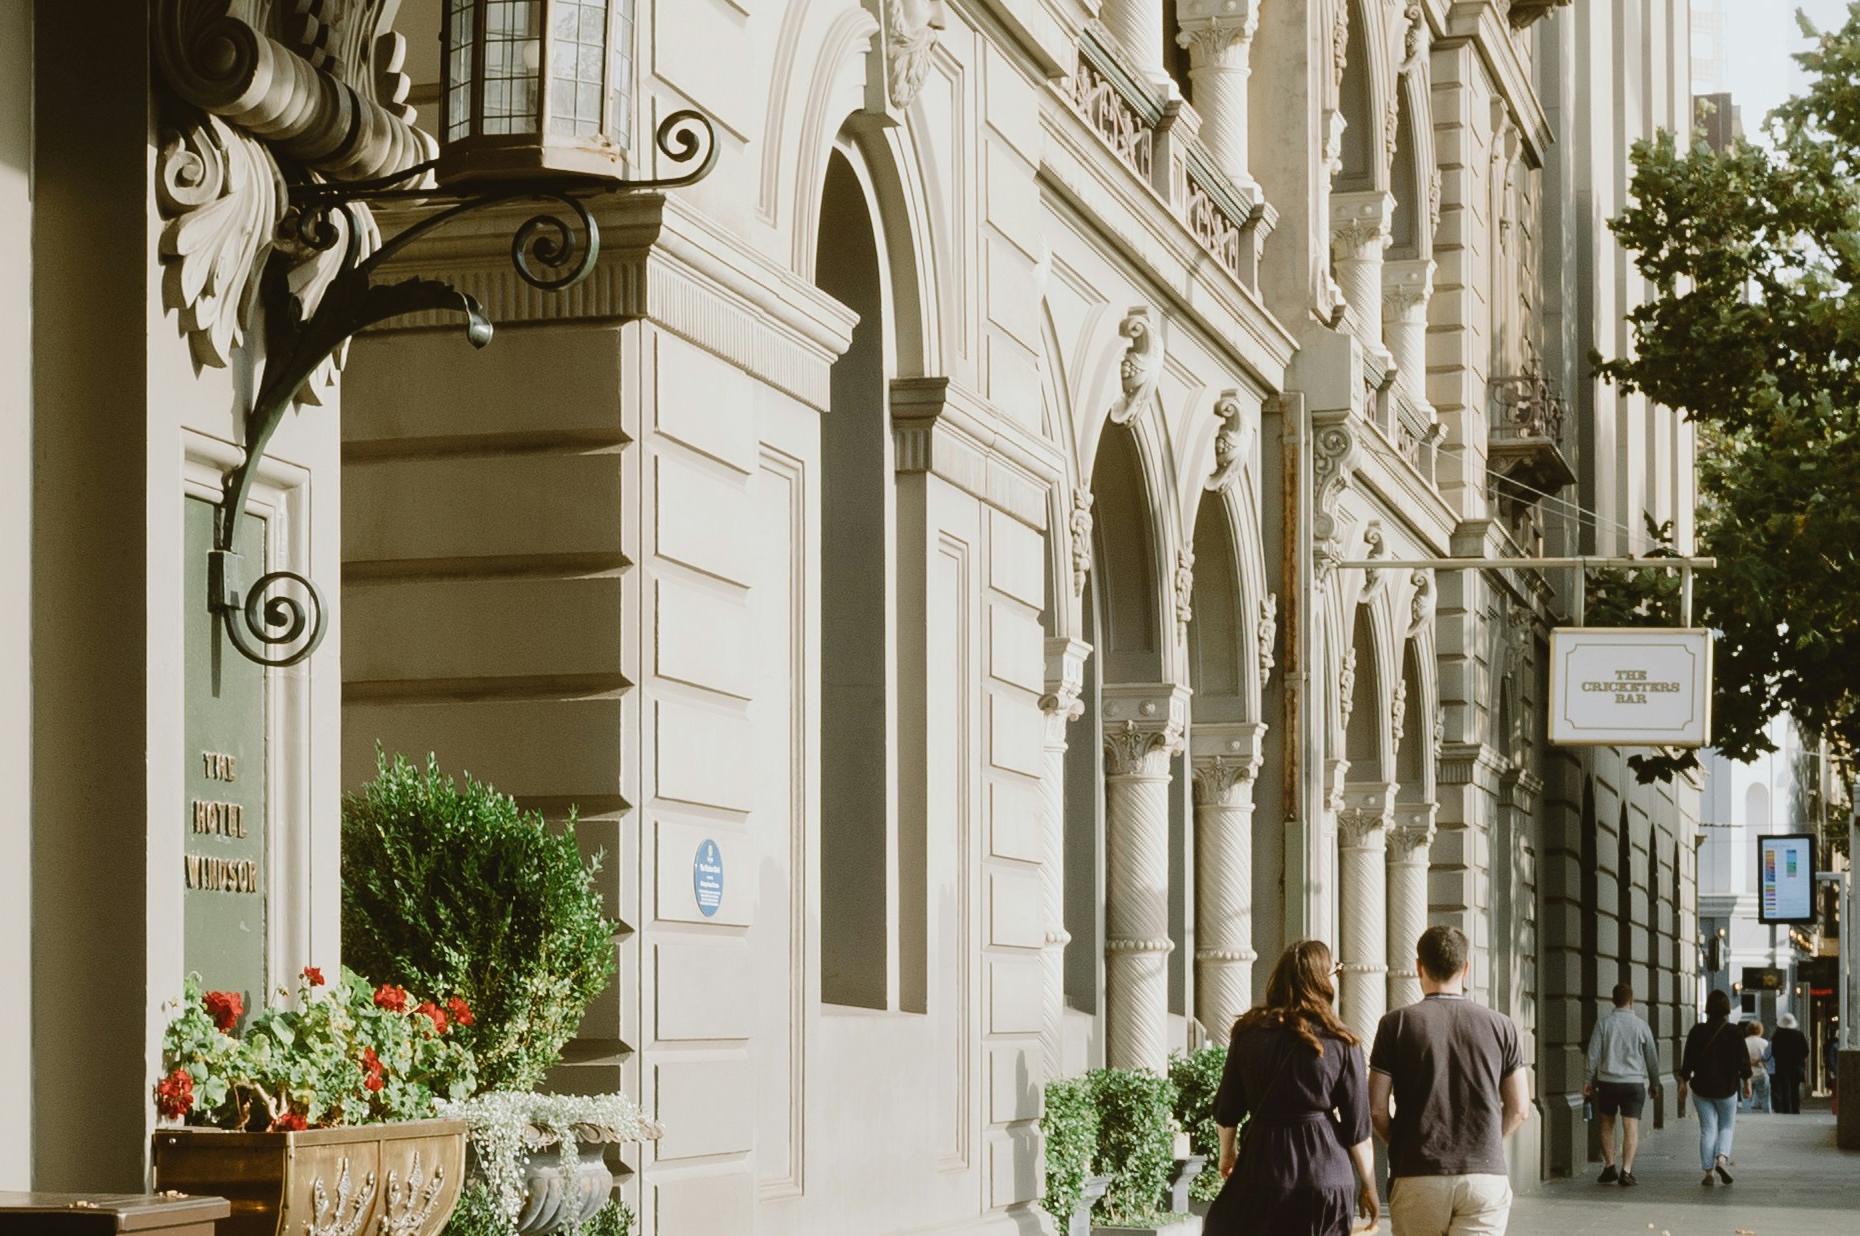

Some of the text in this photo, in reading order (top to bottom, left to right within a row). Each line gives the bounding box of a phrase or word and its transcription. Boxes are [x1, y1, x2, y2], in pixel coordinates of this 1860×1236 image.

[1615, 670, 1647, 680] THE
[1581, 681, 1680, 692] CRICKETERS
[1615, 694, 1647, 704] BAR
[203, 752, 236, 782] THE
[193, 801, 247, 838] HOTEL
[185, 855, 257, 893] WINDSOR
